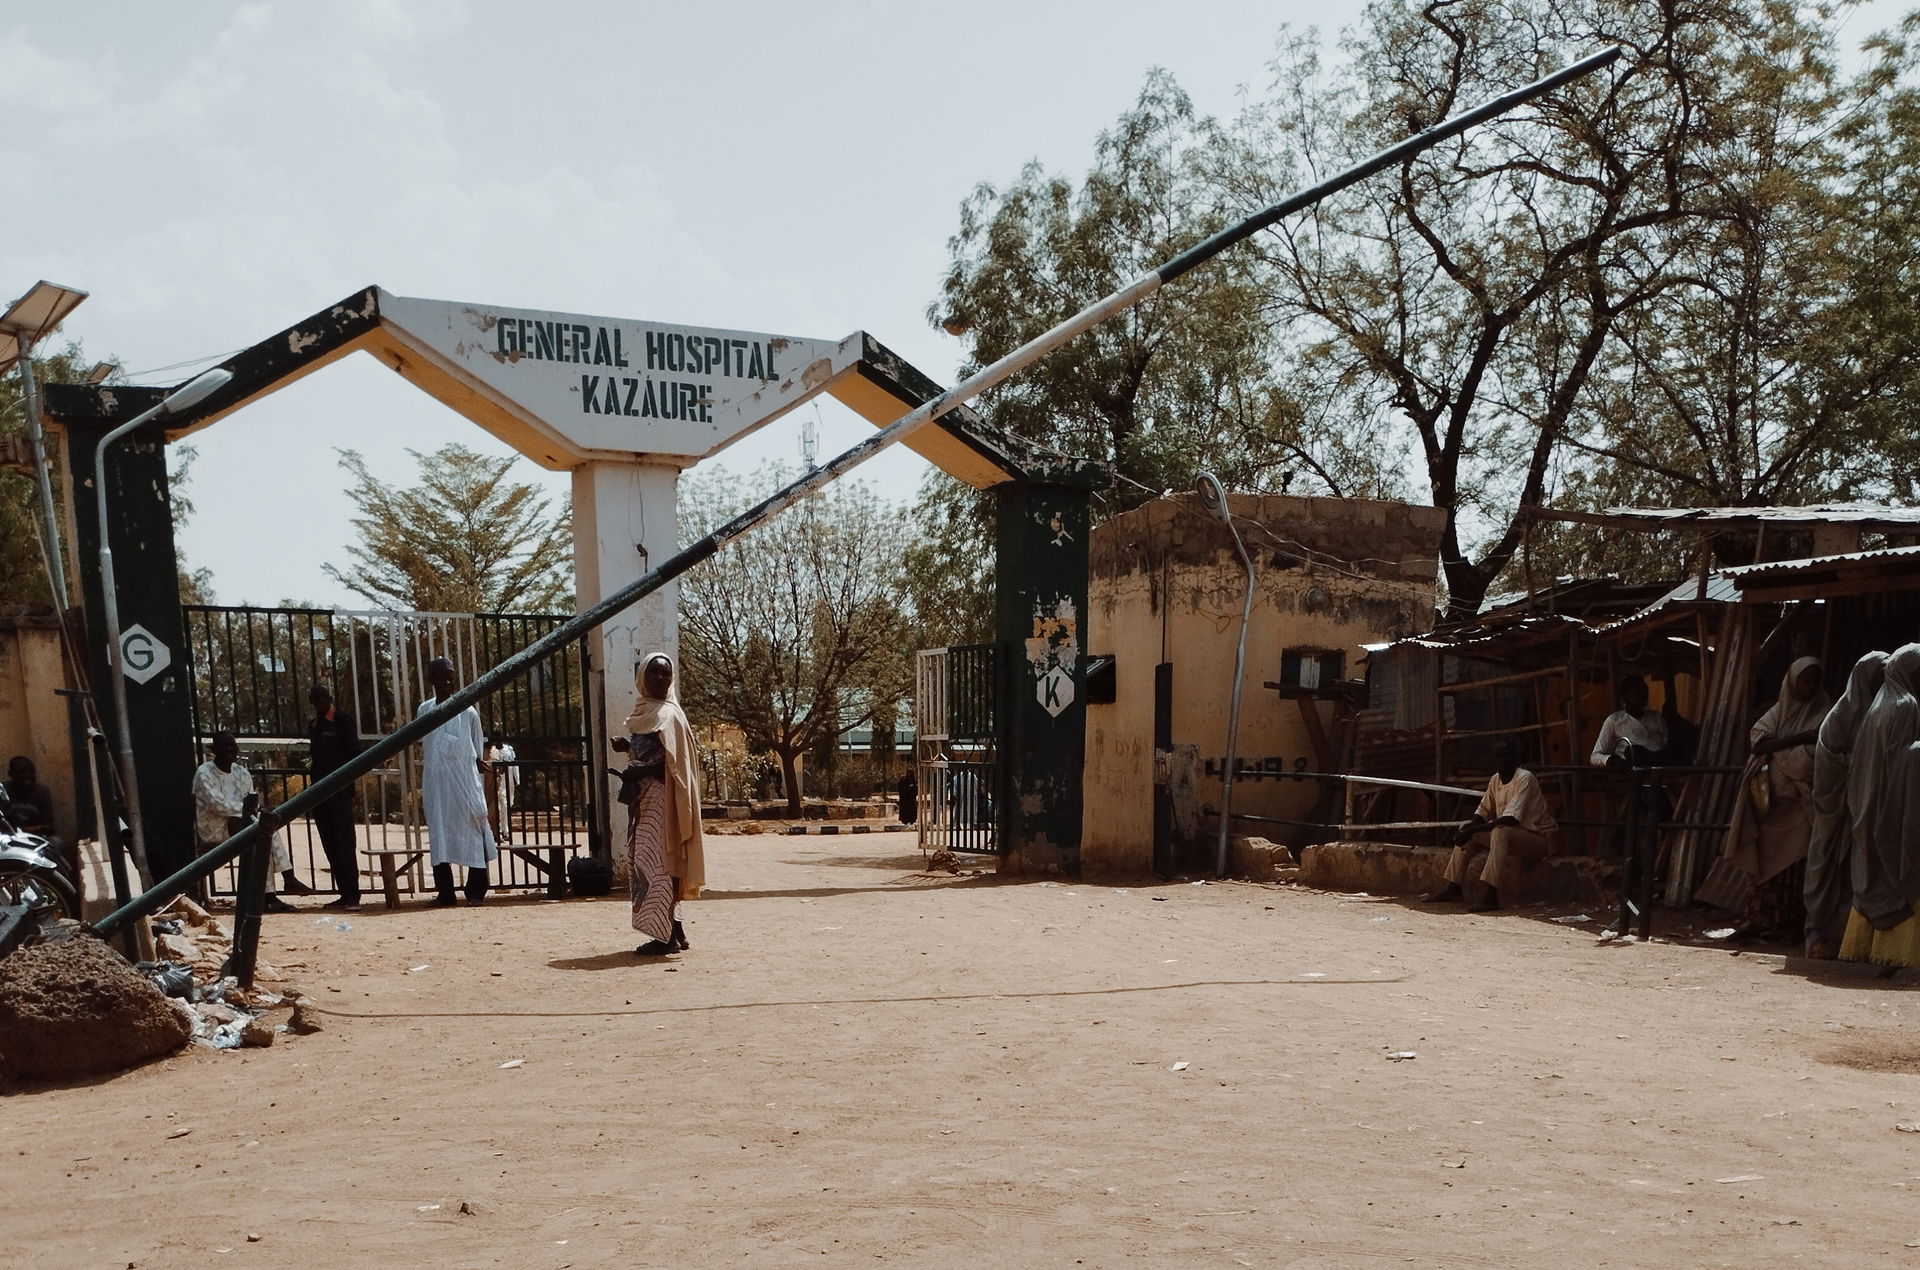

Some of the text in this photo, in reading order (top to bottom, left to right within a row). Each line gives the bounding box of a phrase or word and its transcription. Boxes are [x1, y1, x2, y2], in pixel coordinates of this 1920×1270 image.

[496, 316, 780, 382] GENERAL HOSPITAL
[580, 374, 714, 424] KAZAURE
[122, 633, 155, 671] G
[1045, 675, 1061, 708] K
